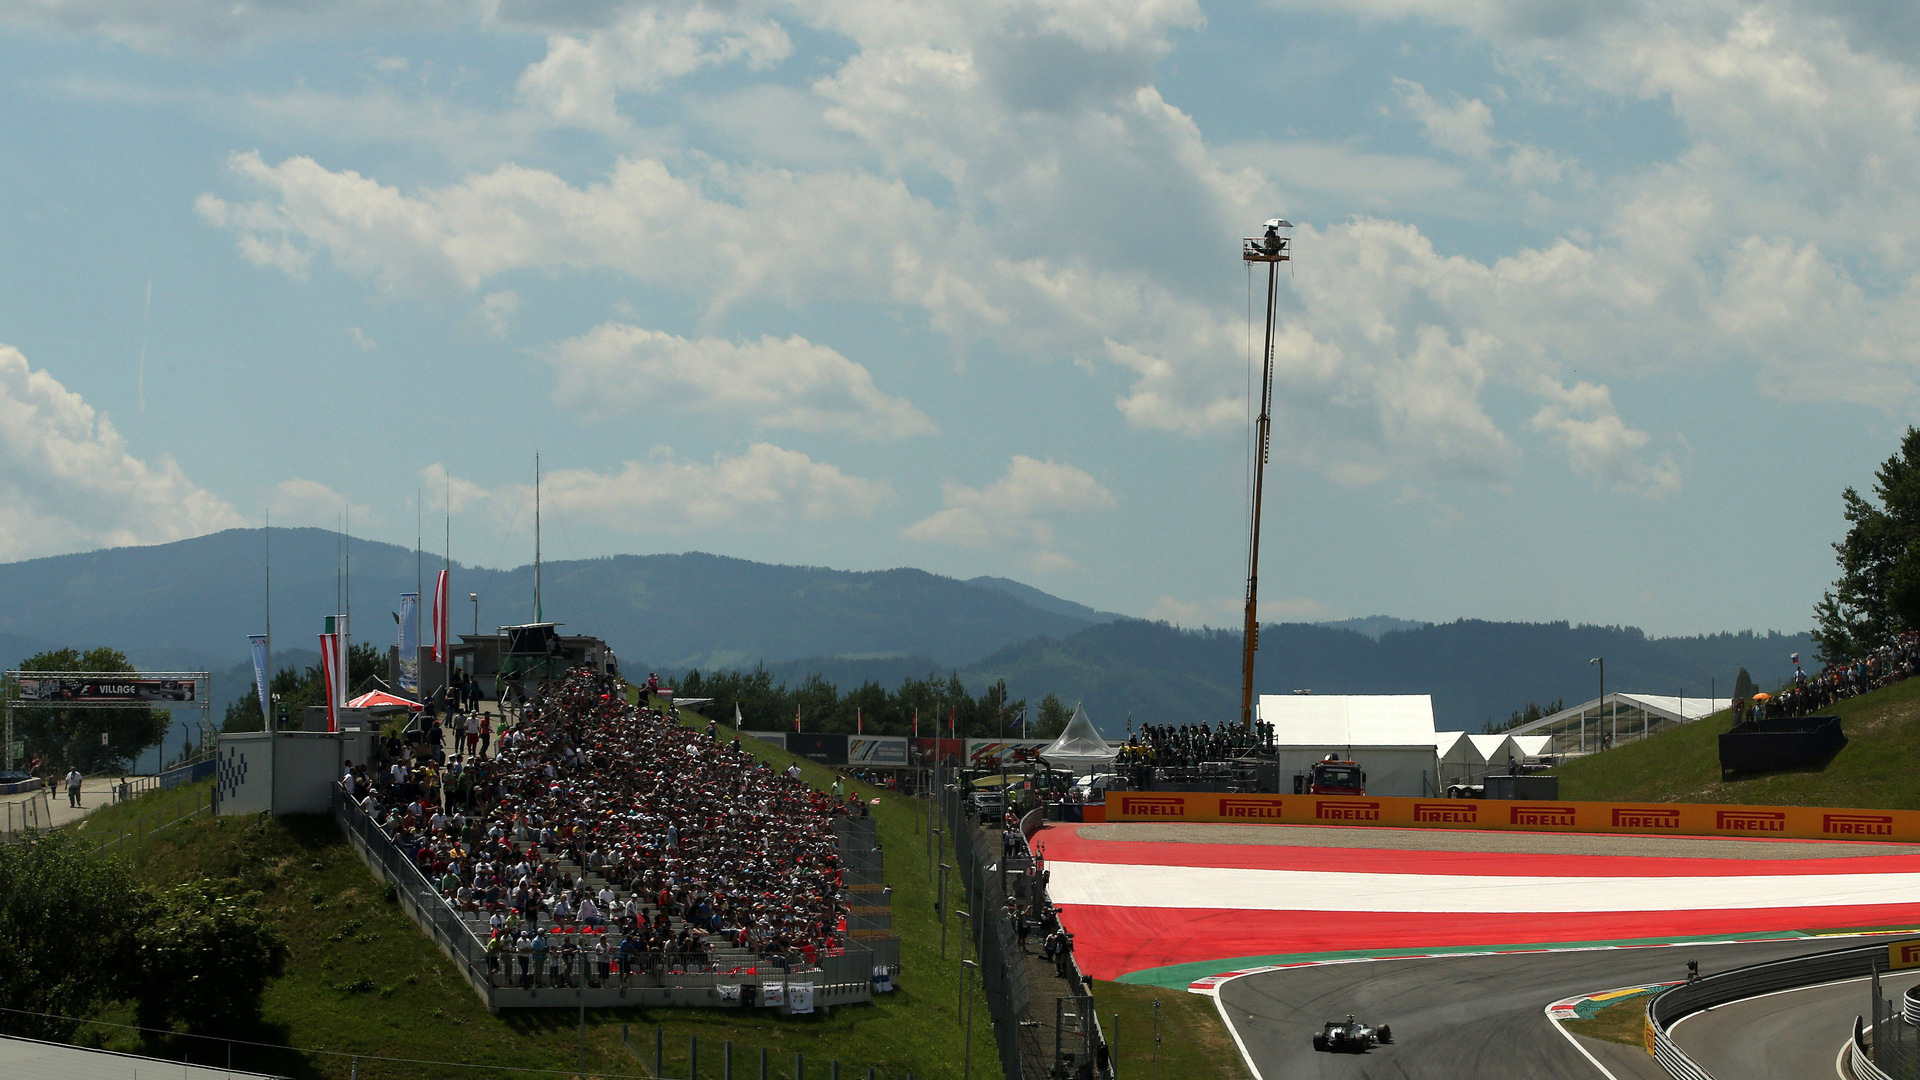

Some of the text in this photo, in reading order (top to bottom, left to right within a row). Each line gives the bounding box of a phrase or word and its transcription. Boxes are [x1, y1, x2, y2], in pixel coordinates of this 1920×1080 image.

[99, 685, 135, 694] VILLAGE
[1122, 797, 1184, 815] PIRELLI
[1219, 799, 1282, 817] PIRELLI
[1316, 801, 1380, 820] PIRELLI
[1414, 804, 1477, 822] PIRELLI
[1510, 807, 1575, 825] PIRELLI
[1612, 809, 1680, 828] PIRELLI
[1717, 811, 1785, 832] PIRELLI
[1823, 814, 1893, 835] PIRELLI
